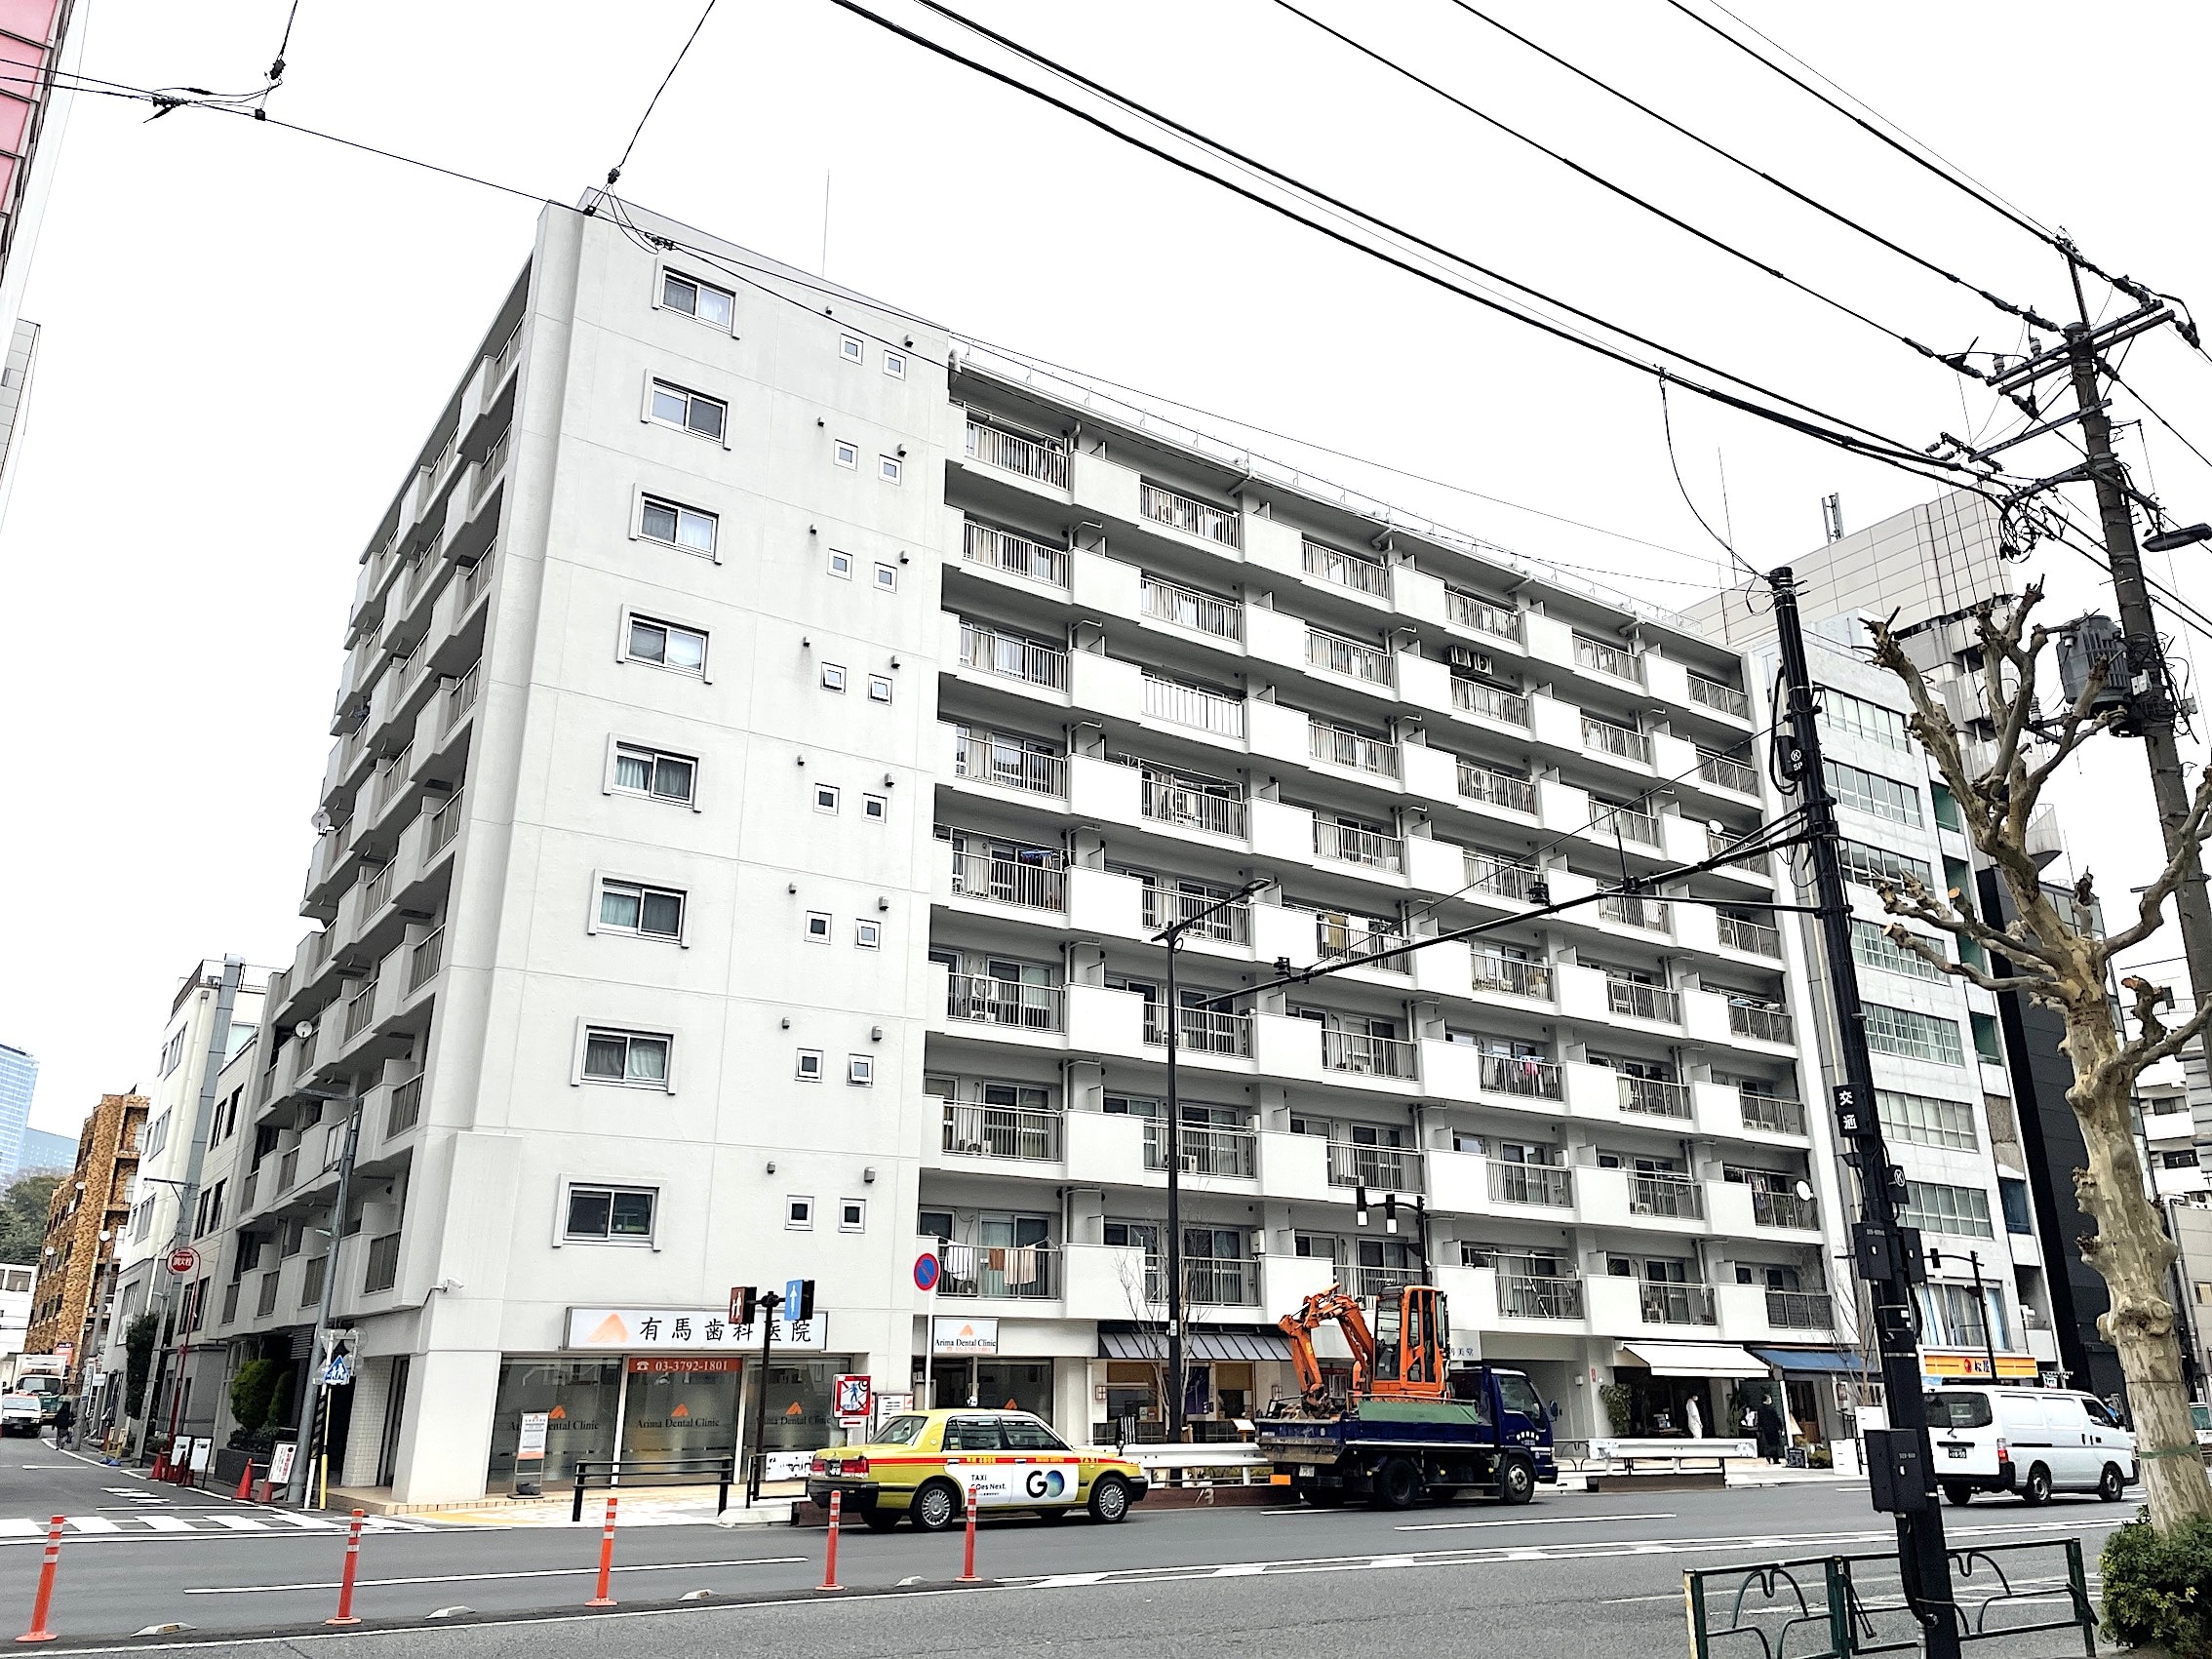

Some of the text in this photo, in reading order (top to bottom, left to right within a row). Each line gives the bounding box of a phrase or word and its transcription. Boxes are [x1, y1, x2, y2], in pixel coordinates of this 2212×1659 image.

[1794, 762, 1802, 770] SP
[1839, 1090, 1857, 1129] 交通
[640, 1316, 811, 1342] 有馬歯科医院
[655, 1361, 728, 1371] 03-3792-1801
[573, 1420, 599, 1430] Clinic
[637, 1418, 720, 1428] Arima Dental Clinic
[781, 1416, 806, 1425] Dental
[1026, 1470, 1064, 1498] GO
